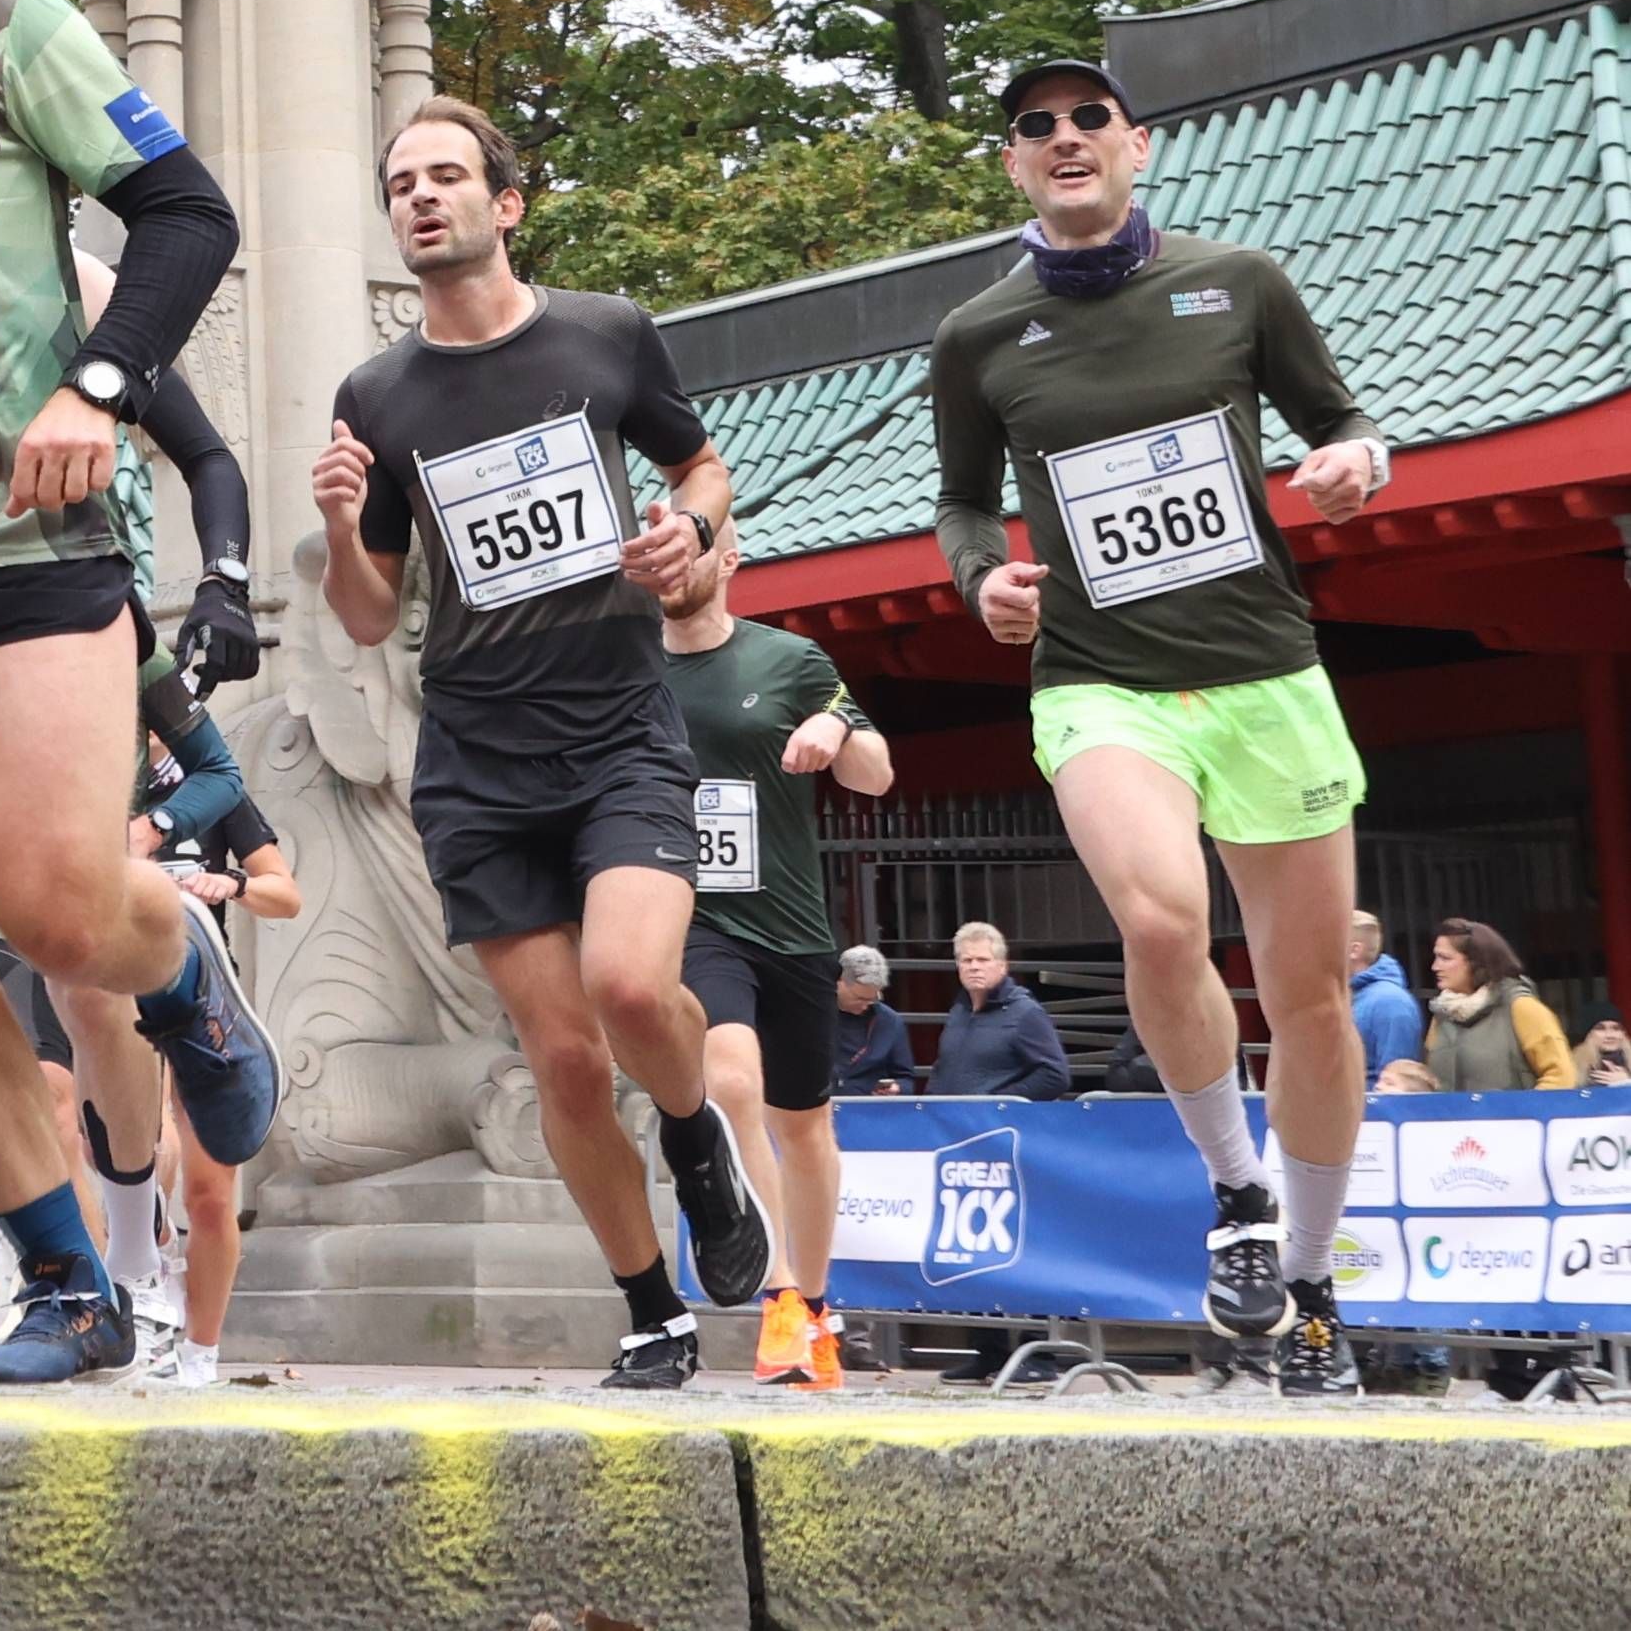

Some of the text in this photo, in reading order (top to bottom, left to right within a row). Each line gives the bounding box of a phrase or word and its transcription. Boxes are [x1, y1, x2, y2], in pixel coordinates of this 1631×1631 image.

[1170, 292, 1200, 302] BMW
[506, 488, 532, 503] 10KM
[1136, 484, 1164, 499] 10KM
[467, 489, 586, 570] 5597
[1092, 488, 1226, 565] 5368
[941, 1161, 1012, 1188] GREAT
[836, 1189, 914, 1224] degewo
[1331, 1248, 1383, 1269] eradio
[1459, 1240, 1534, 1276] degewo
